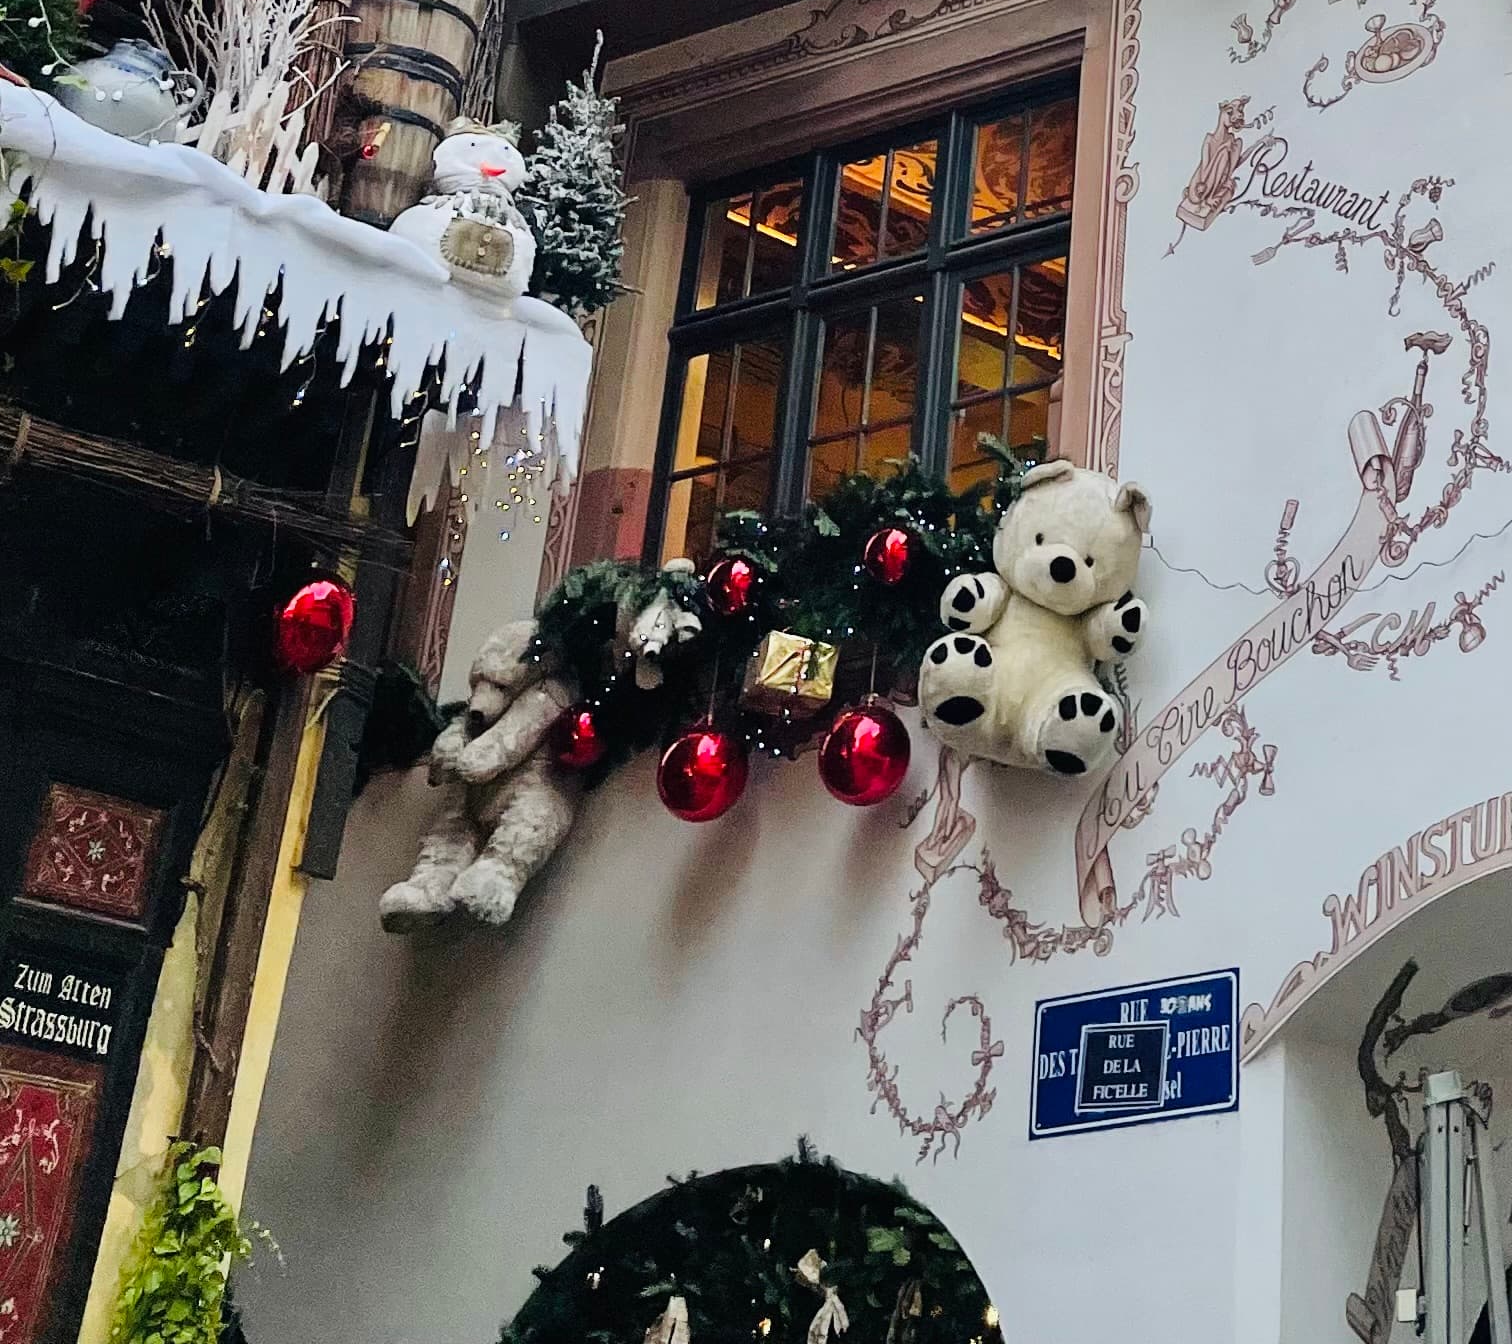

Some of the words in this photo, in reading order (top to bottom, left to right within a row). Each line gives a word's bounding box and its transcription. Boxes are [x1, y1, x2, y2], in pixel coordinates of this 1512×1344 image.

[1233, 136, 1390, 231] Restaurant
[1147, 686, 1218, 766] Tire
[1224, 553, 1364, 705] Bouchon
[14, 964, 53, 995] Zum
[57, 975, 112, 1009] Alten
[0, 997, 112, 1055] Strassburg
[1120, 999, 1149, 1024] RUE
[1108, 1034, 1135, 1049] RUE
[1039, 1051, 1066, 1080] DES
[1104, 1060, 1121, 1074] DE
[1123, 1059, 1141, 1073] LA
[1093, 1083, 1149, 1100] FICELLE
